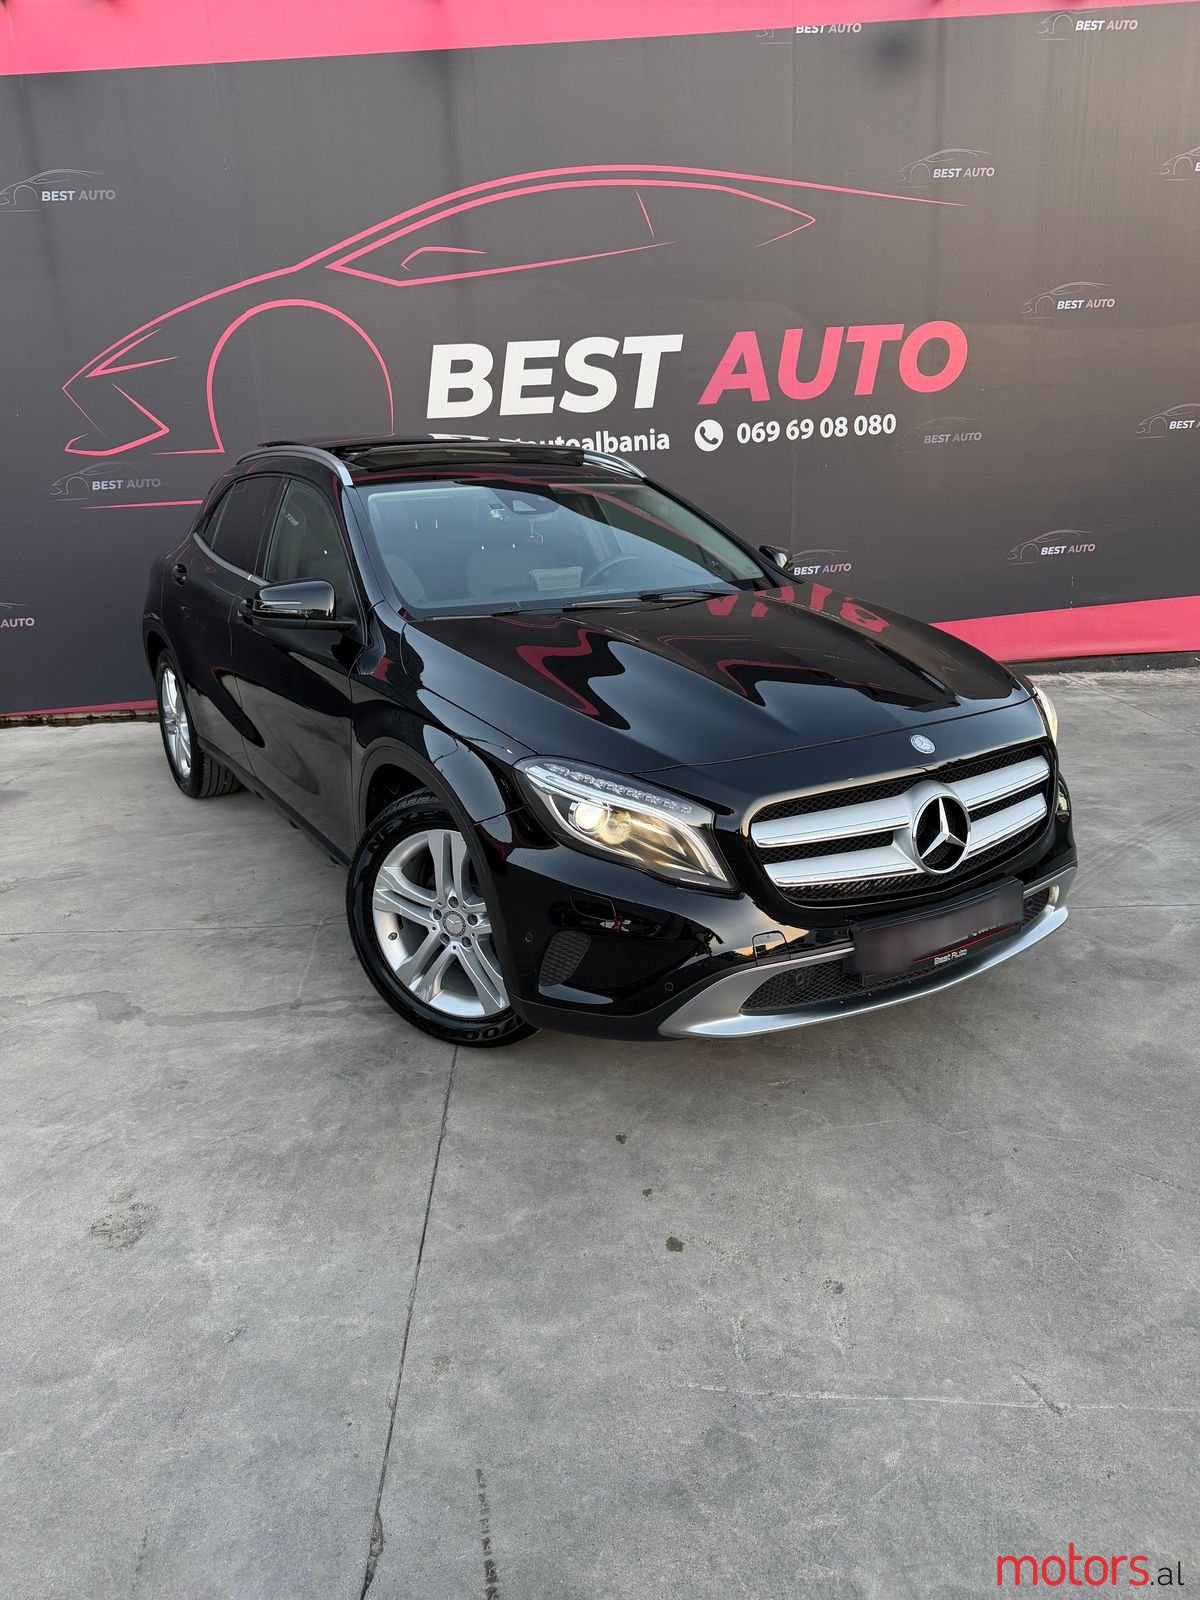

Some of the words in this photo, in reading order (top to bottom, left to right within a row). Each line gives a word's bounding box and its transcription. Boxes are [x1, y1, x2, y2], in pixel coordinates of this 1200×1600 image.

[795, 25, 826, 34] BEST
[828, 22, 862, 34] AUTO
[1075, 20, 1105, 31] BEST
[1106, 19, 1138, 31] AUTO
[932, 168, 962, 179] BEST
[963, 167, 995, 178] AUTO
[41, 190, 76, 202] BEST
[78, 189, 116, 201] AUTO
[1056, 300, 1084, 310] BEST
[1085, 298, 1116, 309] AUTO
[426, 334, 684, 419] BEST
[697, 320, 968, 405] AUTO
[736, 421, 781, 444] 069
[785, 419, 814, 441] 69
[819, 416, 848, 438] 08
[853, 413, 897, 436] 080
[1169, 420, 1195, 430] BEST
[924, 434, 951, 444] BEST
[952, 432, 982, 442] AUTO
[92, 480, 124, 491] BEST
[126, 478, 161, 489] AUTO
[1040, 545, 1067, 556] BEST
[1067, 543, 1096, 554] AUTO
[793, 565, 821, 576] BEST
[822, 562, 852, 574] AUTO
[0, 617, 35, 628] AUTO
